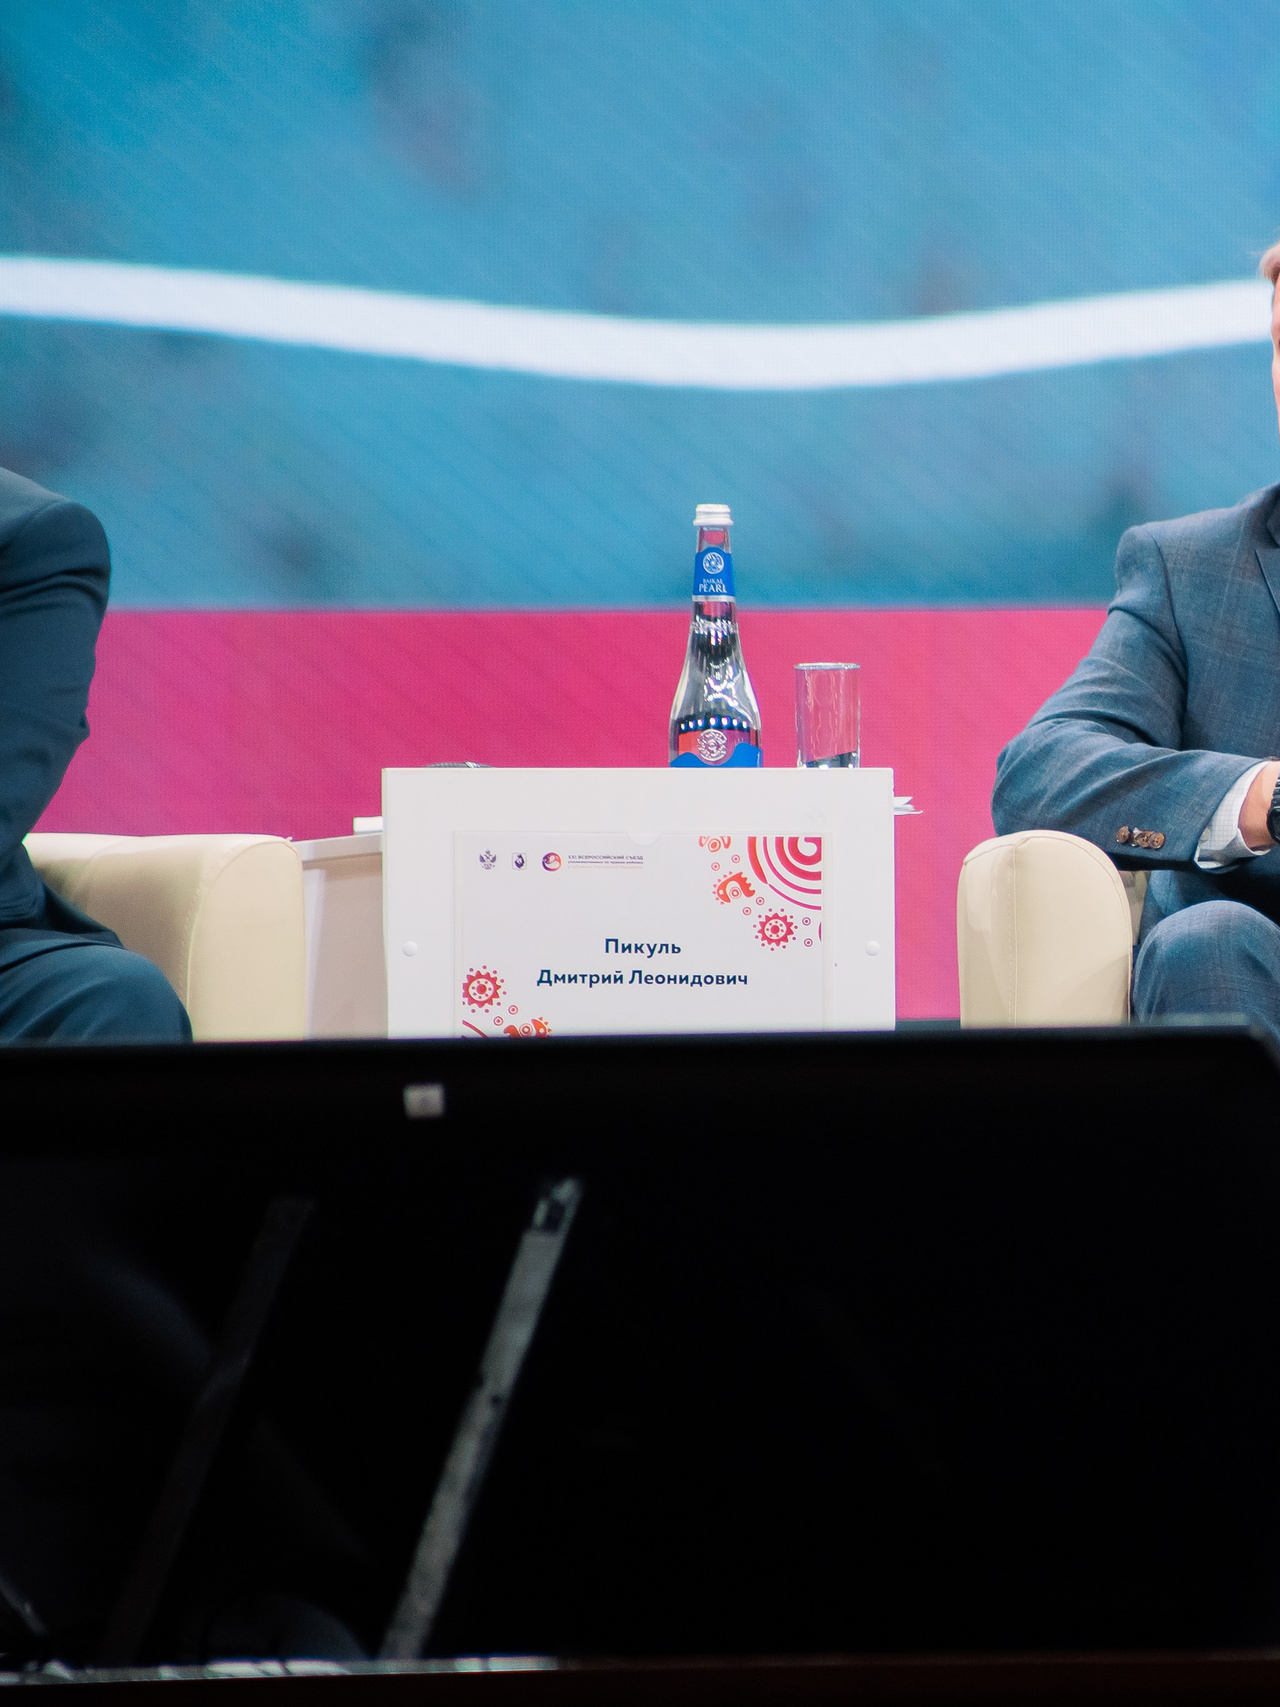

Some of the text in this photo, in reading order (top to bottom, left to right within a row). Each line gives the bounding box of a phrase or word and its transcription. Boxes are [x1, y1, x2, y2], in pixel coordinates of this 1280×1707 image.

[698, 583, 727, 593] PEARL
[604, 938, 682, 959] Пикуль
[536, 968, 749, 988] Дмитрий Леонидович
